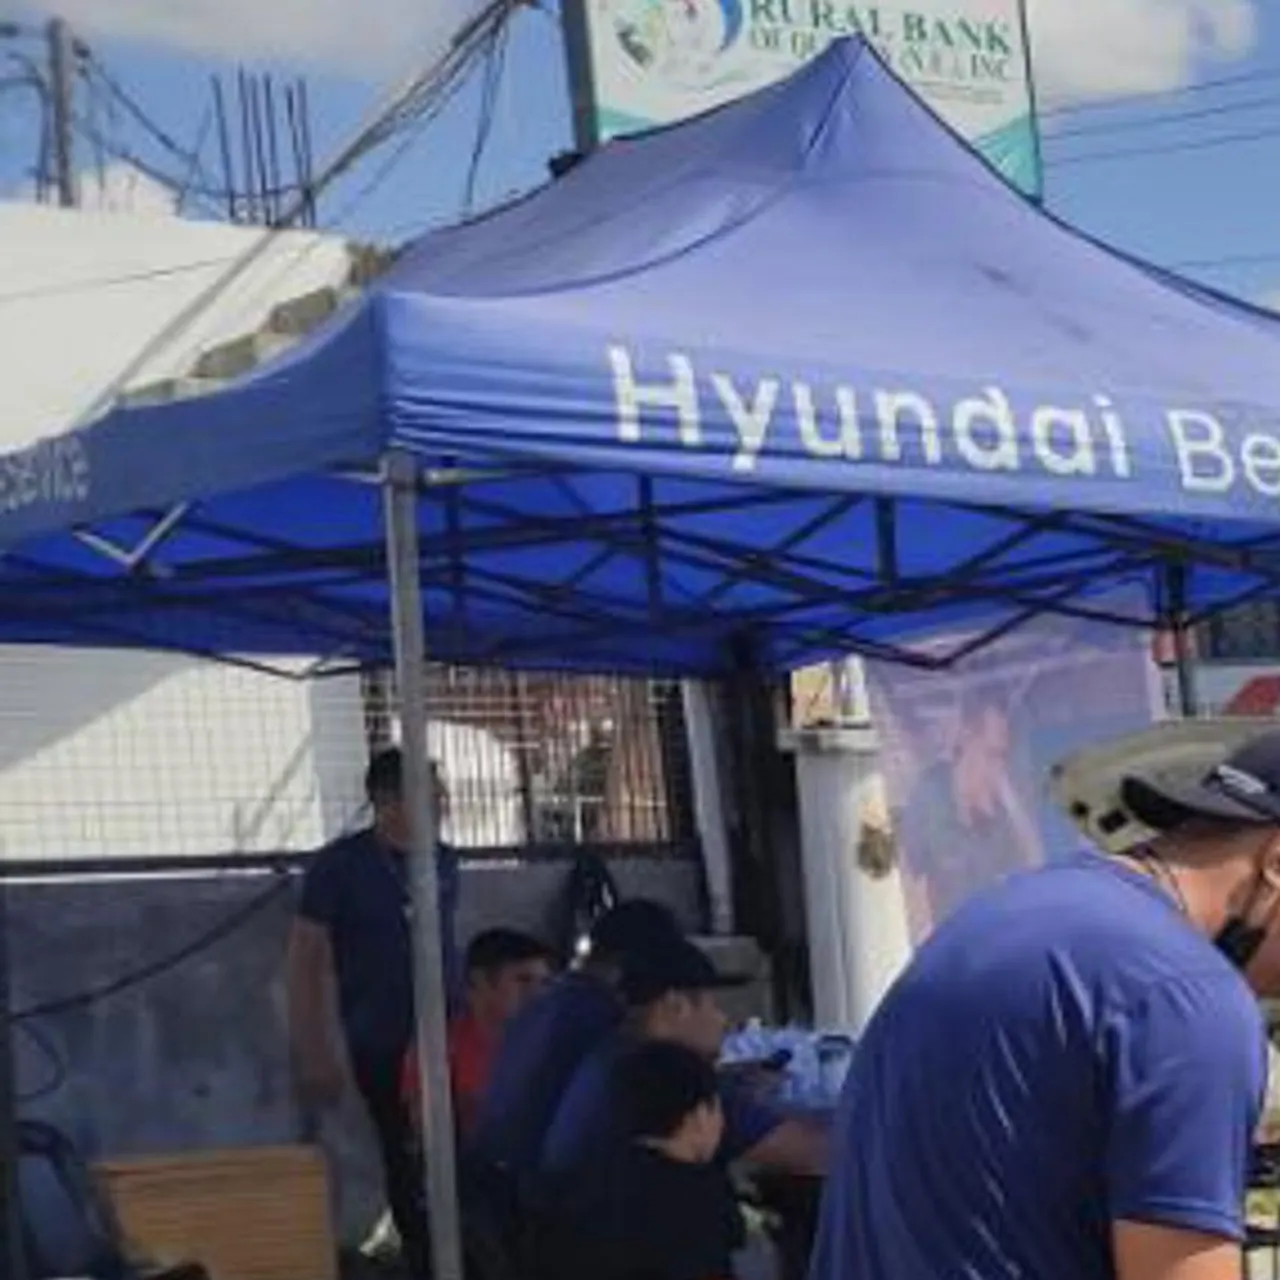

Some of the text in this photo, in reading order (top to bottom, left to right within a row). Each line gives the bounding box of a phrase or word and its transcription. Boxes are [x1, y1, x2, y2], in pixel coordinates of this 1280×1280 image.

[751, 0, 1011, 54] RURAL BANK
[606, 344, 1131, 478] Hyundai
